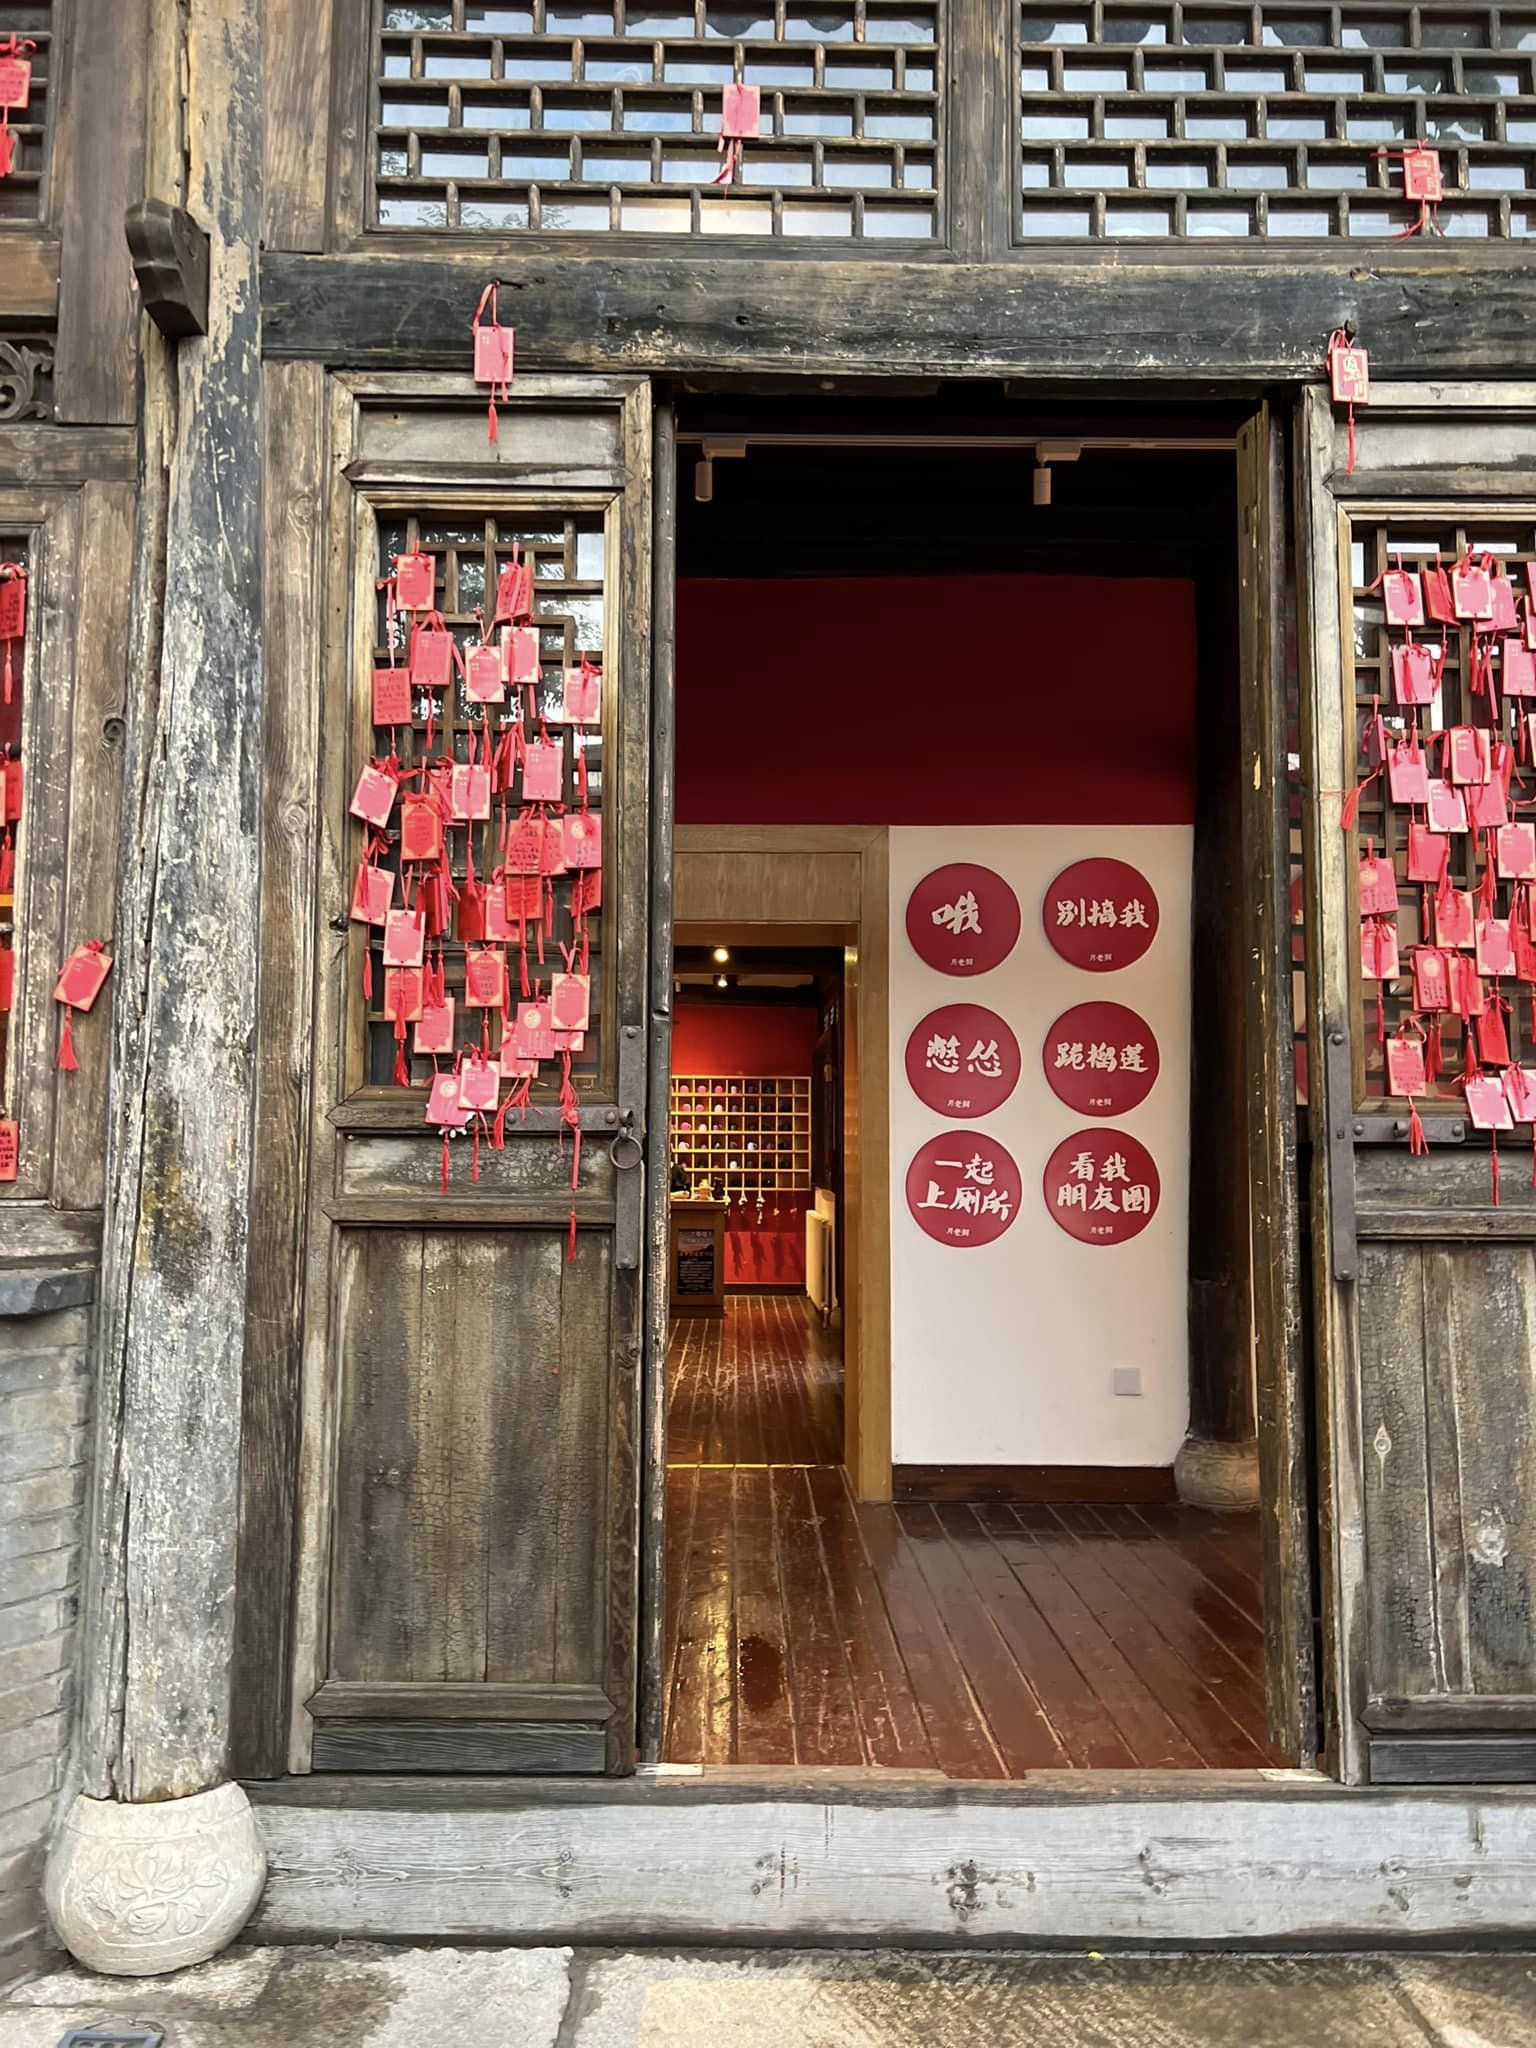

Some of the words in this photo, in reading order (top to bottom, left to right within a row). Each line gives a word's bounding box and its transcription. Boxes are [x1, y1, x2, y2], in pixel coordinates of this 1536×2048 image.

[925, 1033, 1003, 1078] 憋怂
[934, 1152, 995, 1185] 一起
[1068, 1151, 1131, 1182] 看我
[916, 1180, 1014, 1222] 上厕所
[1056, 1182, 1152, 1214] 朋友圈
